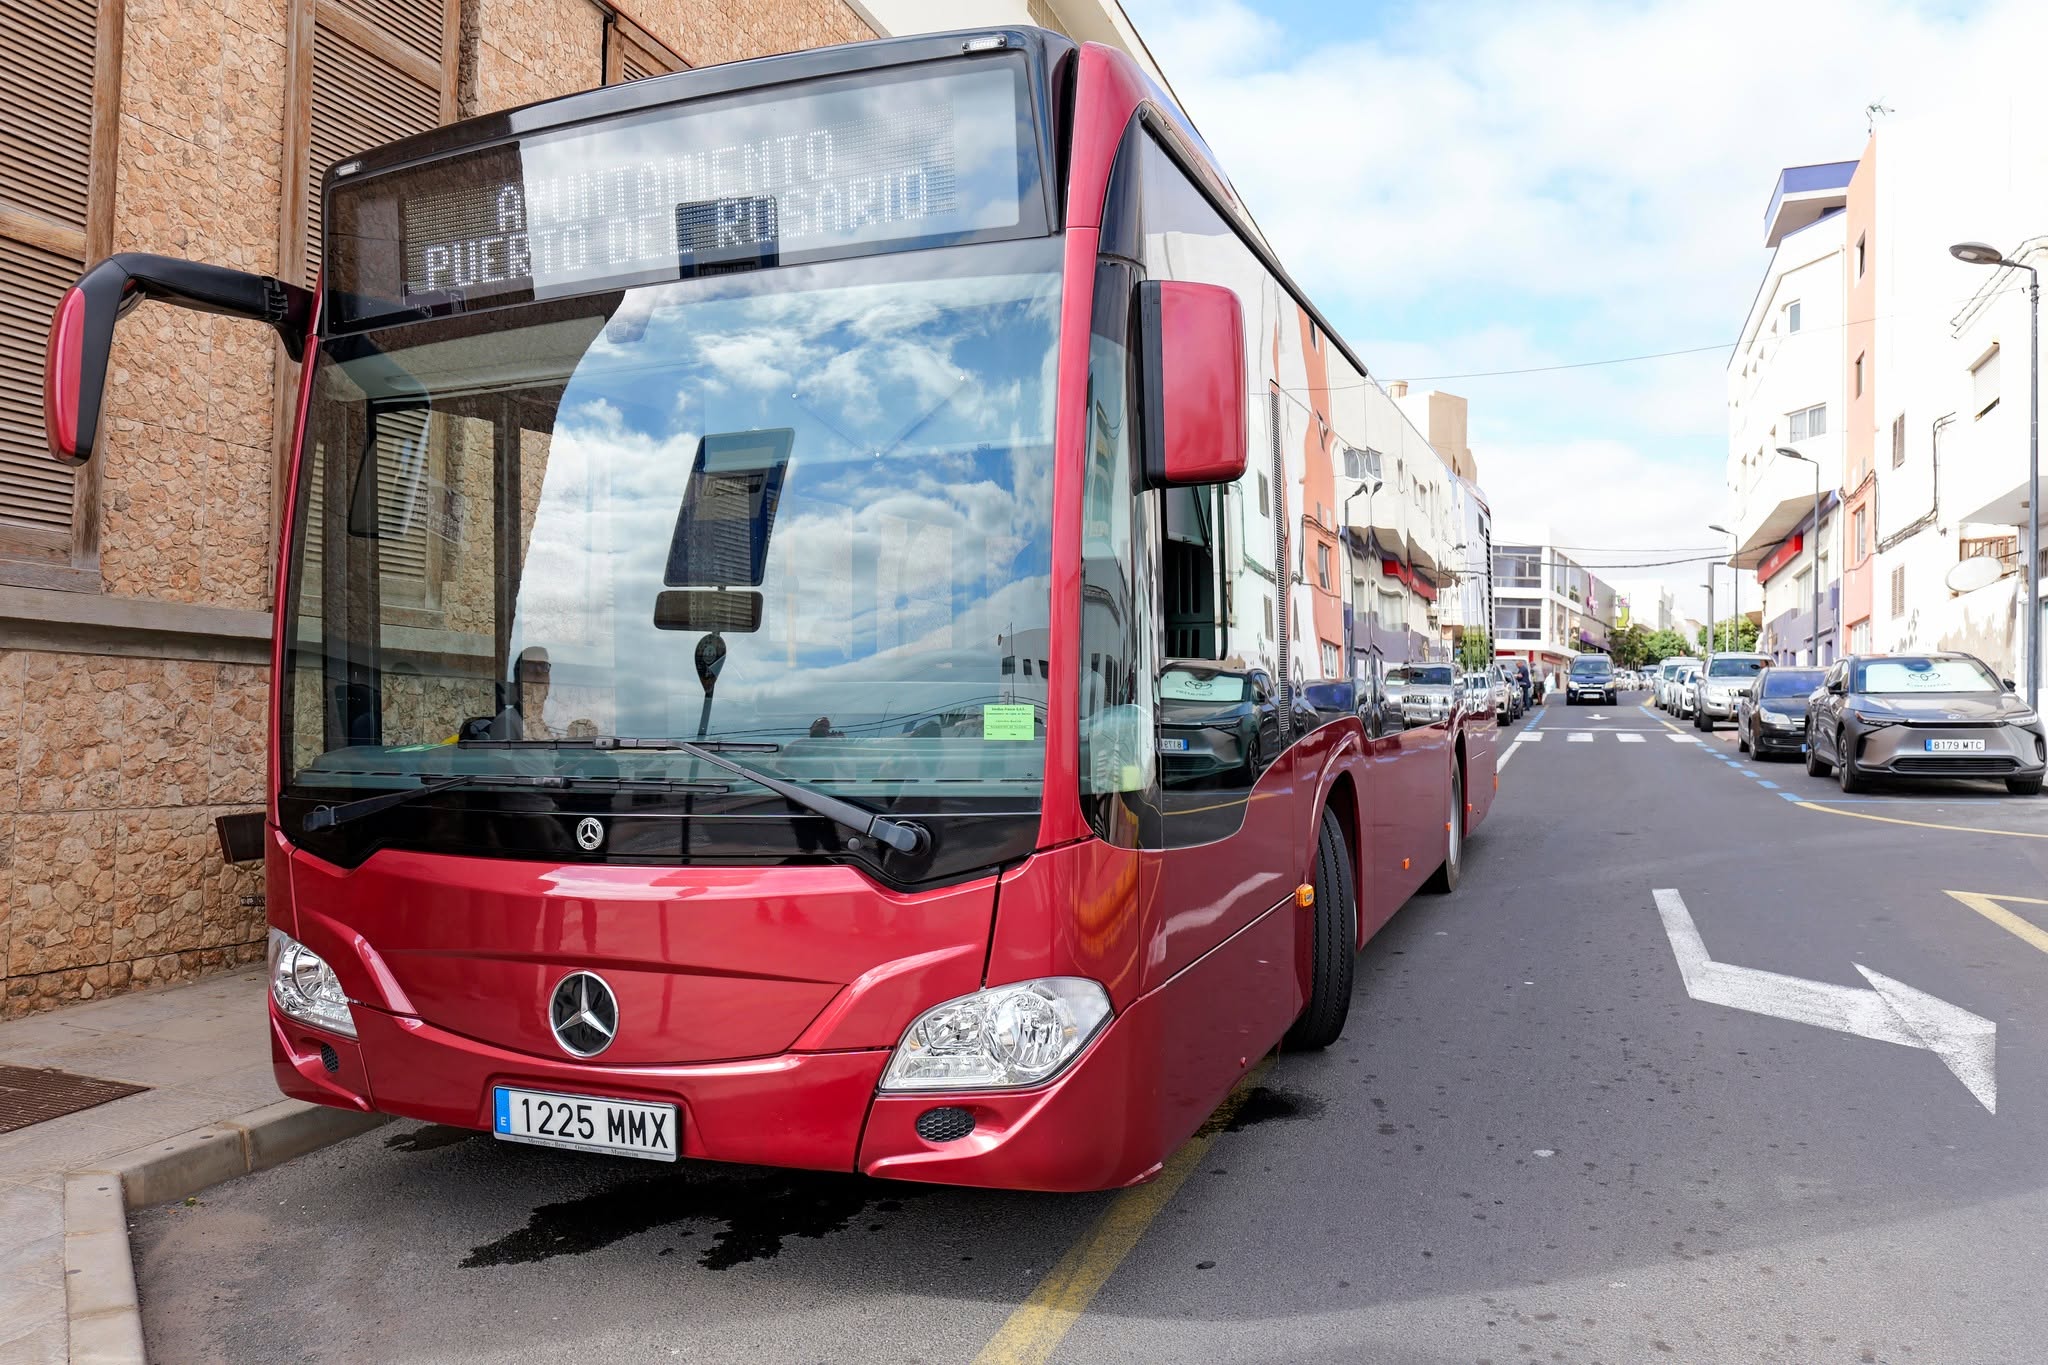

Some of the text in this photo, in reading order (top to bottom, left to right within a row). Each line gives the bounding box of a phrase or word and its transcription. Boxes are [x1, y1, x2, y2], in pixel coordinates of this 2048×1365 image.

[499, 129, 833, 231] AYUNTAMIENTO
[427, 167, 927, 291] PUERTO DEL ROSARIO
[1934, 741, 1982, 750] 8179 MTC
[500, 1116, 507, 1126] E
[521, 1098, 668, 1149] 1225 MMX
